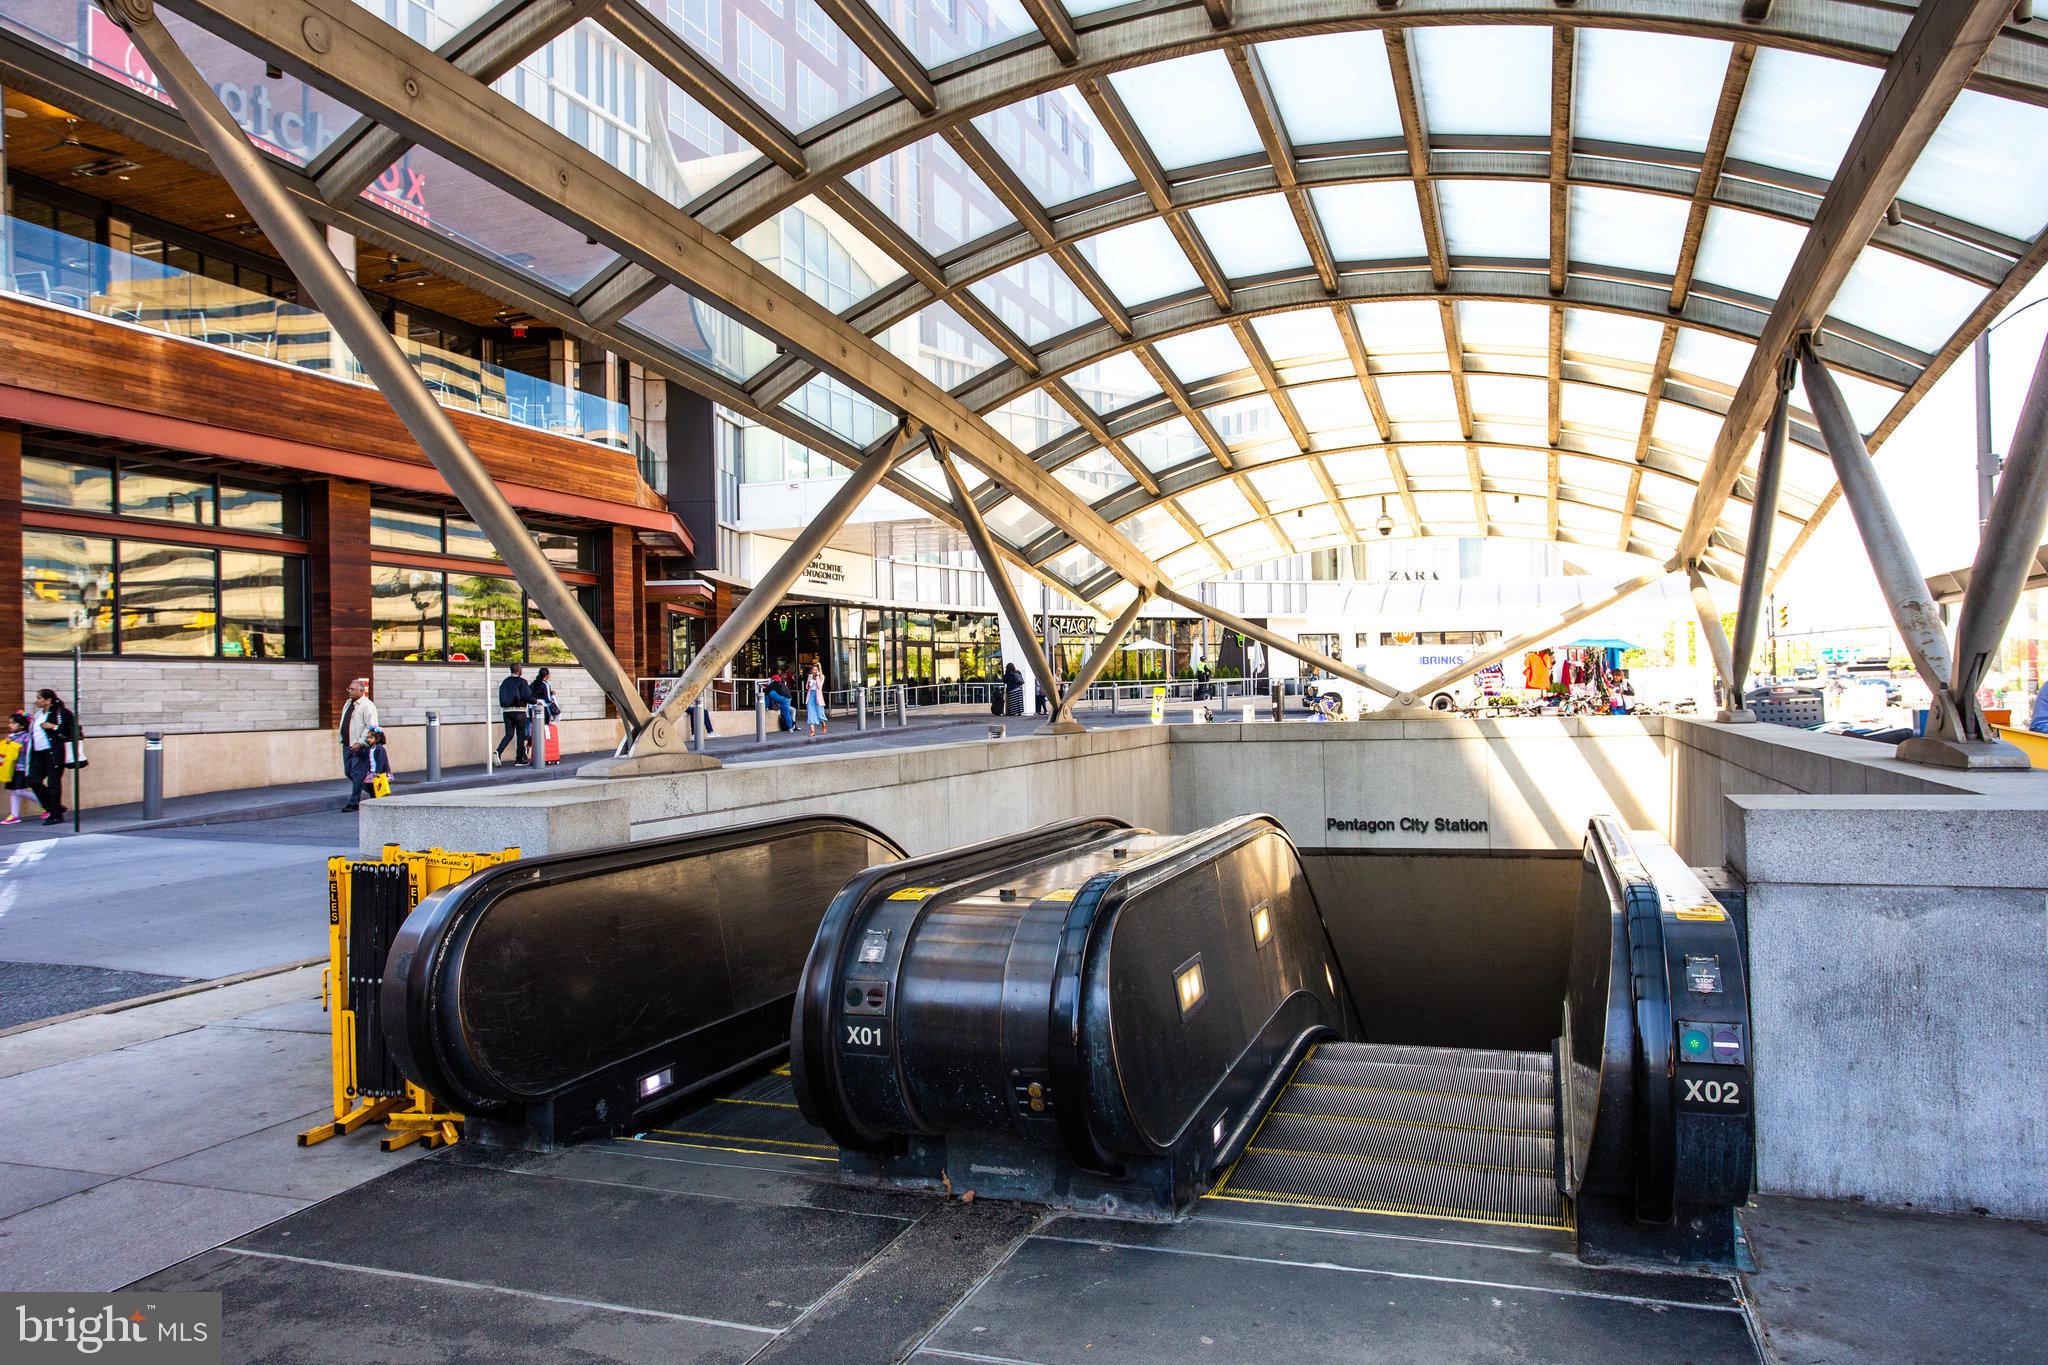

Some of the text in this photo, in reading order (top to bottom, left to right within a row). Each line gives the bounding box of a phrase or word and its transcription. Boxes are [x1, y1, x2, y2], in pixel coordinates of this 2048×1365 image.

[802, 569, 846, 582] ENTAGON CITY
[818, 562, 842, 573] CENTRE
[1389, 571, 1440, 581] ZARA
[1051, 616, 1095, 635] SHACK
[1422, 656, 1464, 665] BRINKS
[1326, 817, 1489, 834] Pentagon City Station
[329, 869, 339, 922] MELES
[846, 1025, 882, 1047] X01
[1684, 1079, 1740, 1104] X02
